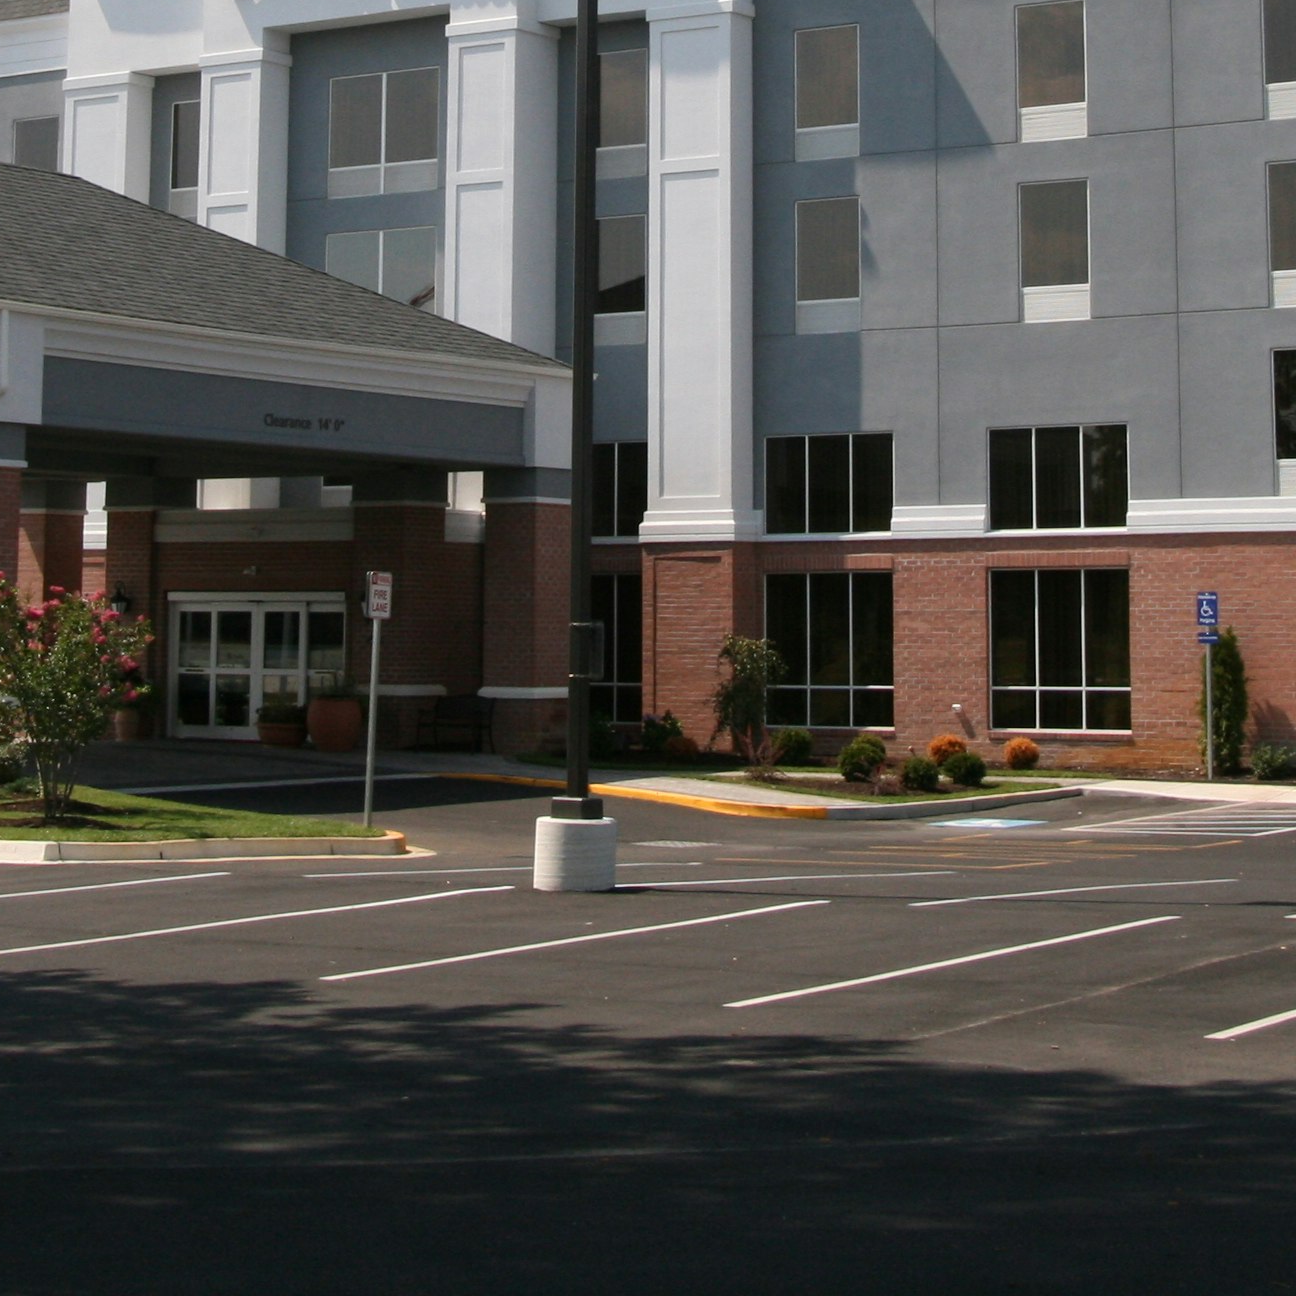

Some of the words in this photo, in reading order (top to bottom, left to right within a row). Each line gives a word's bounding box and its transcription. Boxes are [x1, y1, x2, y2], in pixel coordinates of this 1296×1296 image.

[264, 413, 313, 430] Clearance
[374, 589, 388, 601] FIRE
[372, 602, 388, 613] LANE
